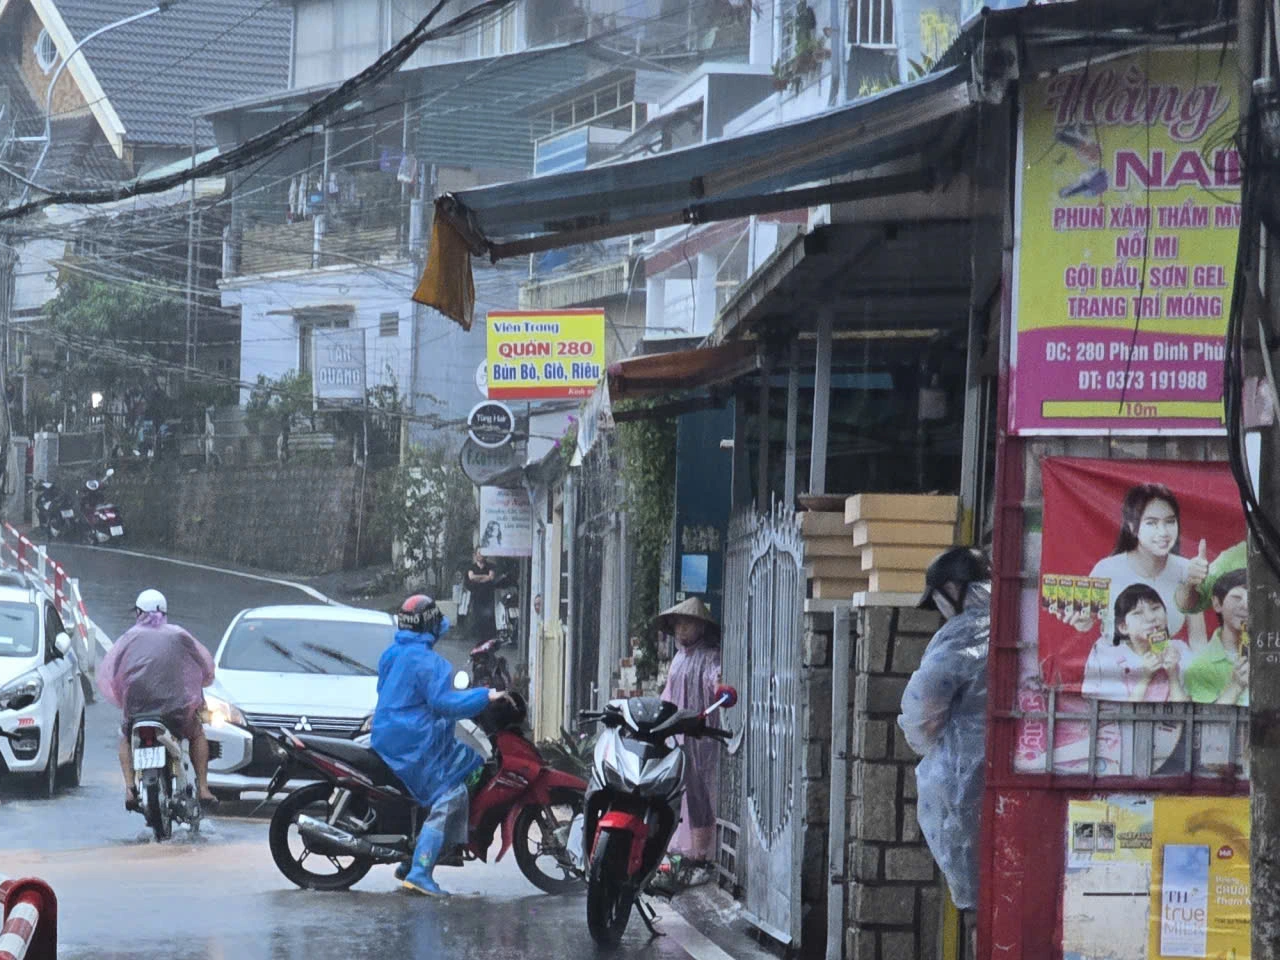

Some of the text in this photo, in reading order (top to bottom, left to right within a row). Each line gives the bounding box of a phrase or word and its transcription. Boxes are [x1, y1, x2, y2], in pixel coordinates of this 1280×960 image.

[1053, 206, 1105, 229] PHUN
[1154, 236, 1178, 258] MI
[1065, 263, 1096, 294] GỘI
[1150, 265, 1188, 289] SƠN
[1193, 266, 1226, 288] GEL
[1067, 292, 1222, 319] TRANG TRÍ MÓNG
[557, 341, 594, 356] 280
[1046, 341, 1071, 361] ĐC:
[1076, 341, 1105, 361] 280
[1109, 341, 1149, 361] Phan
[1153, 341, 1188, 361] Đình
[520, 362, 540, 381] Bò,
[1079, 370, 1207, 390] ĐT: 0373 191988
[1125, 403, 1158, 417] 10m
[1165, 890, 1188, 903] TH
[1165, 904, 1205, 922] true
